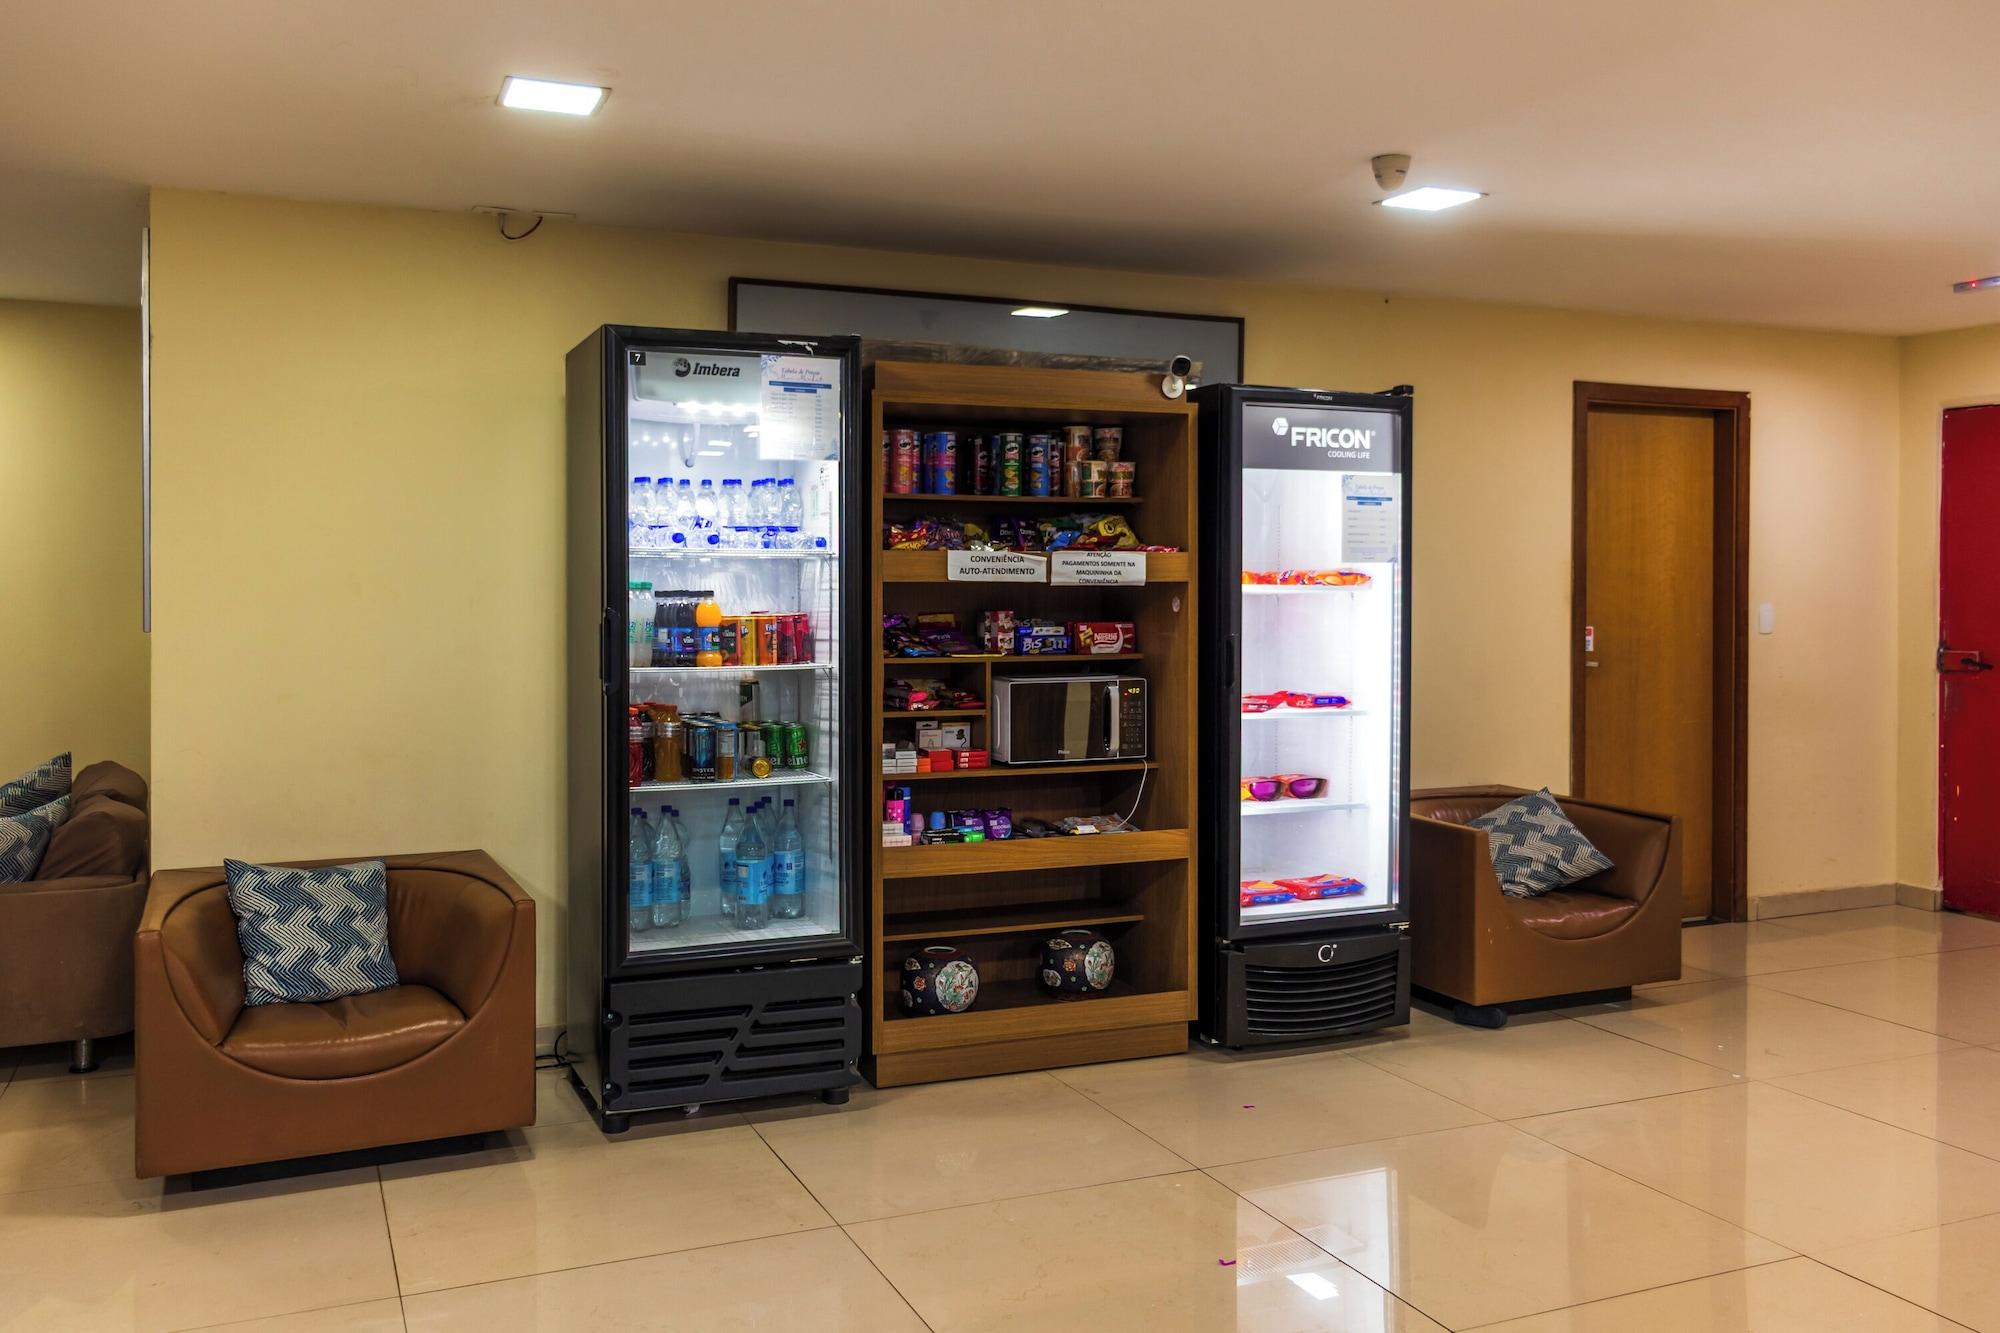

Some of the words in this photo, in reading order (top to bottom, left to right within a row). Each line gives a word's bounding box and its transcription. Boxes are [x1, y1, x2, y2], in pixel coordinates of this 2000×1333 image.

[634, 353, 641, 363] 7
[692, 362, 741, 377] Imbera
[1291, 427, 1371, 449] FRICON
[1327, 450, 1357, 458] COOLING
[1357, 451, 1371, 459] LIFE
[970, 554, 1025, 563] CONVENIÊNCIA
[1086, 551, 1112, 559] ATENÇÃO
[959, 567, 1035, 575] AUTO-ATENDIMENTO
